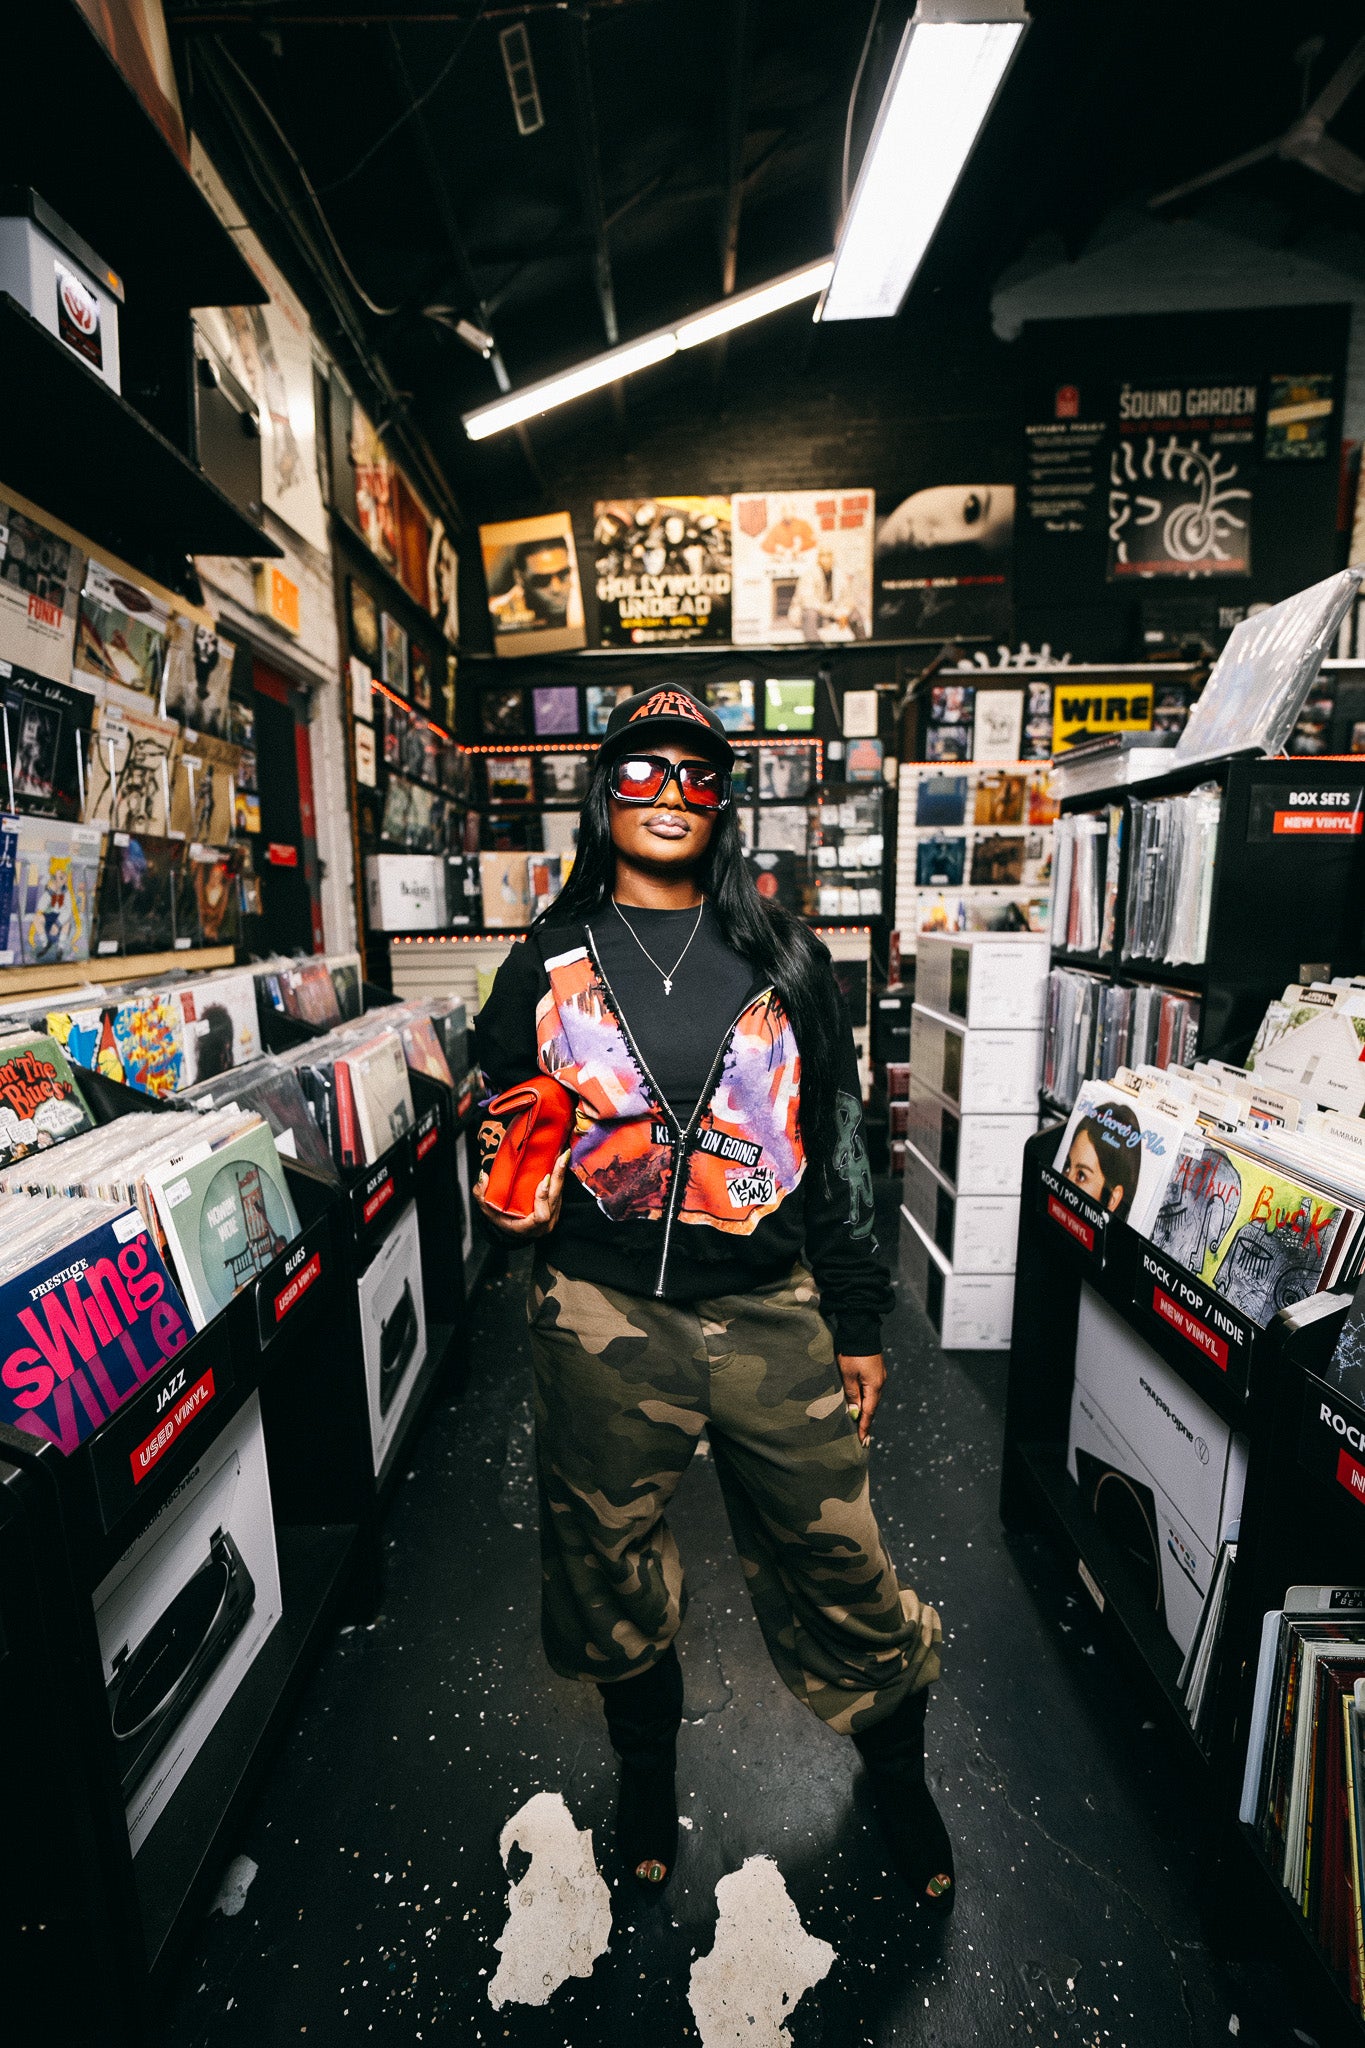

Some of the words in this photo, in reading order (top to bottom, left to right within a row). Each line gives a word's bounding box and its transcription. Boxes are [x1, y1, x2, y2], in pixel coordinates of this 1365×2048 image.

[1119, 385, 1181, 418] SOUND
[1186, 386, 1257, 415] GARDEN
[595, 573, 731, 602] HOLLYWOOD
[618, 595, 711, 619] UNDEAD
[628, 699, 711, 728] KILLS
[1061, 695, 1150, 722] WIRE
[1288, 792, 1318, 805] BOX
[1319, 792, 1350, 806] SETS
[1283, 816, 1314, 829] NEW
[1316, 816, 1352, 829] VINYL
[15, 1050, 57, 1083] The
[701, 1131, 722, 1152] ON
[720, 1137, 759, 1166] GOING
[1097, 1109, 1132, 1137] Secret
[1126, 1130, 1146, 1148] of
[1142, 1130, 1166, 1156] Us
[1330, 1127, 1363, 1146] BAMBARA
[1173, 1156, 1239, 1203] Arthur
[1041, 1170, 1060, 1193] ROCK
[1060, 1186, 1065, 1197] /
[1065, 1188, 1079, 1207] POP
[1079, 1202, 1085, 1213] /
[1084, 1204, 1104, 1230] INDIE
[1067, 1215, 1088, 1242] VINYL
[284, 1246, 306, 1276] BLUES
[279, 1283, 298, 1311] USED
[298, 1263, 317, 1288] VINYL
[1143, 1254, 1170, 1287] ROCK
[1171, 1279, 1178, 1292] /
[1180, 1283, 1203, 1310] POP
[1205, 1304, 1212, 1318] /
[1214, 1309, 1244, 1346] INDIE
[1159, 1298, 1184, 1327] NEW
[1185, 1318, 1219, 1358] VINYL
[156, 1368, 186, 1413] JAZZ
[139, 1421, 174, 1467] USED
[174, 1385, 209, 1426] VINYL
[1335, 1591, 1365, 1599] PAN
